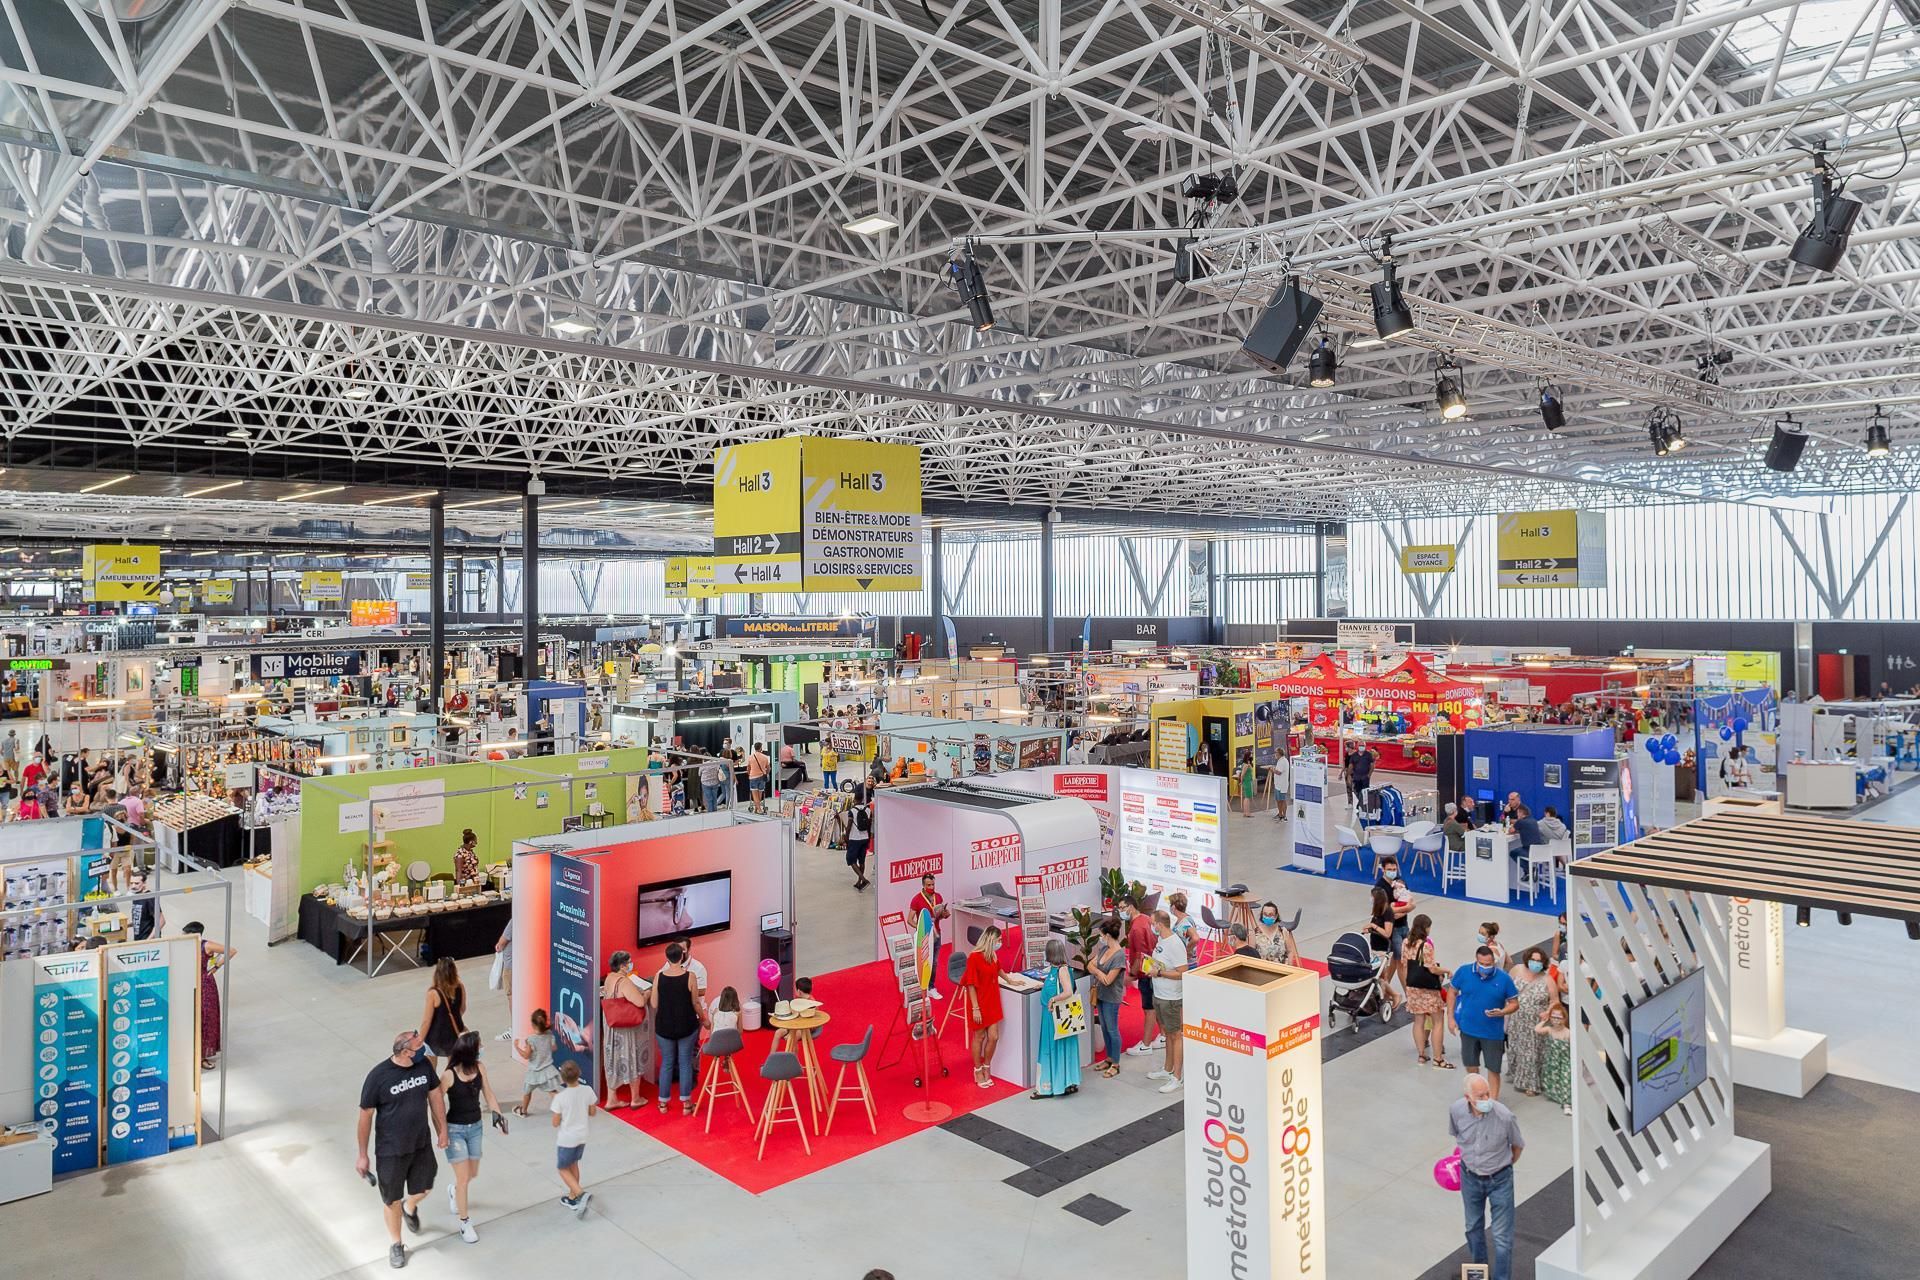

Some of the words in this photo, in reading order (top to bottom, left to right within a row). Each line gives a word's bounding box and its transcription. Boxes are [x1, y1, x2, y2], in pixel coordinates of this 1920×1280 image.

[739, 474, 760, 492] Hall
[762, 472, 770, 490] 3
[840, 472, 869, 490] Hall
[872, 472, 883, 491] 3
[816, 510, 870, 524] BIEN-ÊTRE
[872, 515, 878, 525] &
[880, 515, 910, 526] MODE
[812, 527, 913, 542] DÉMONSTRATEURS
[1520, 529, 1540, 537] Hall
[1542, 527, 1549, 537] 3
[734, 538, 753, 554] Hall
[754, 537, 762, 553] 2
[823, 546, 904, 558] GASTRONOMIE
[813, 563, 855, 574] LOISIRS
[857, 565, 863, 574] &
[864, 564, 913, 574] SERVICES
[1515, 561, 1534, 569] Hall
[1535, 560, 1542, 568] 2
[752, 566, 771, 582] Hall
[773, 565, 781, 581] 4
[1532, 575, 1550, 583] Hall
[744, 623, 787, 632] MAISON
[802, 622, 838, 632] LITERIE
[1136, 624, 1156, 634] BAR
[288, 654, 350, 668] Mobilier
[310, 667, 343, 675] France
[1272, 684, 1324, 696] BONBONS
[1359, 688, 1416, 700] BONBONS
[1445, 688, 1475, 699] BONBONS
[832, 738, 859, 749] BISTRO
[892, 864, 904, 879] LA
[904, 857, 942, 876] DÉPÊCHE
[971, 854, 983, 870] LA
[1050, 868, 1088, 891] DÉPÊCHE
[560, 902, 585, 918] Proximité
[1204, 1022, 1214, 1031] Au
[1218, 1026, 1237, 1037] cœur
[1241, 1031, 1250, 1041] de
[1280, 1030, 1288, 1038] Au
[1304, 1021, 1310, 1029] de
[1187, 1028, 1207, 1039] votre
[1210, 1034, 1250, 1051] quotidien
[390, 1075, 427, 1094] adidas
[1203, 1061, 1228, 1208] toulouse
[1280, 1067, 1298, 1220] toulouse
[1225, 1104, 1251, 1280] métropole
[1294, 1097, 1312, 1274] métropole
